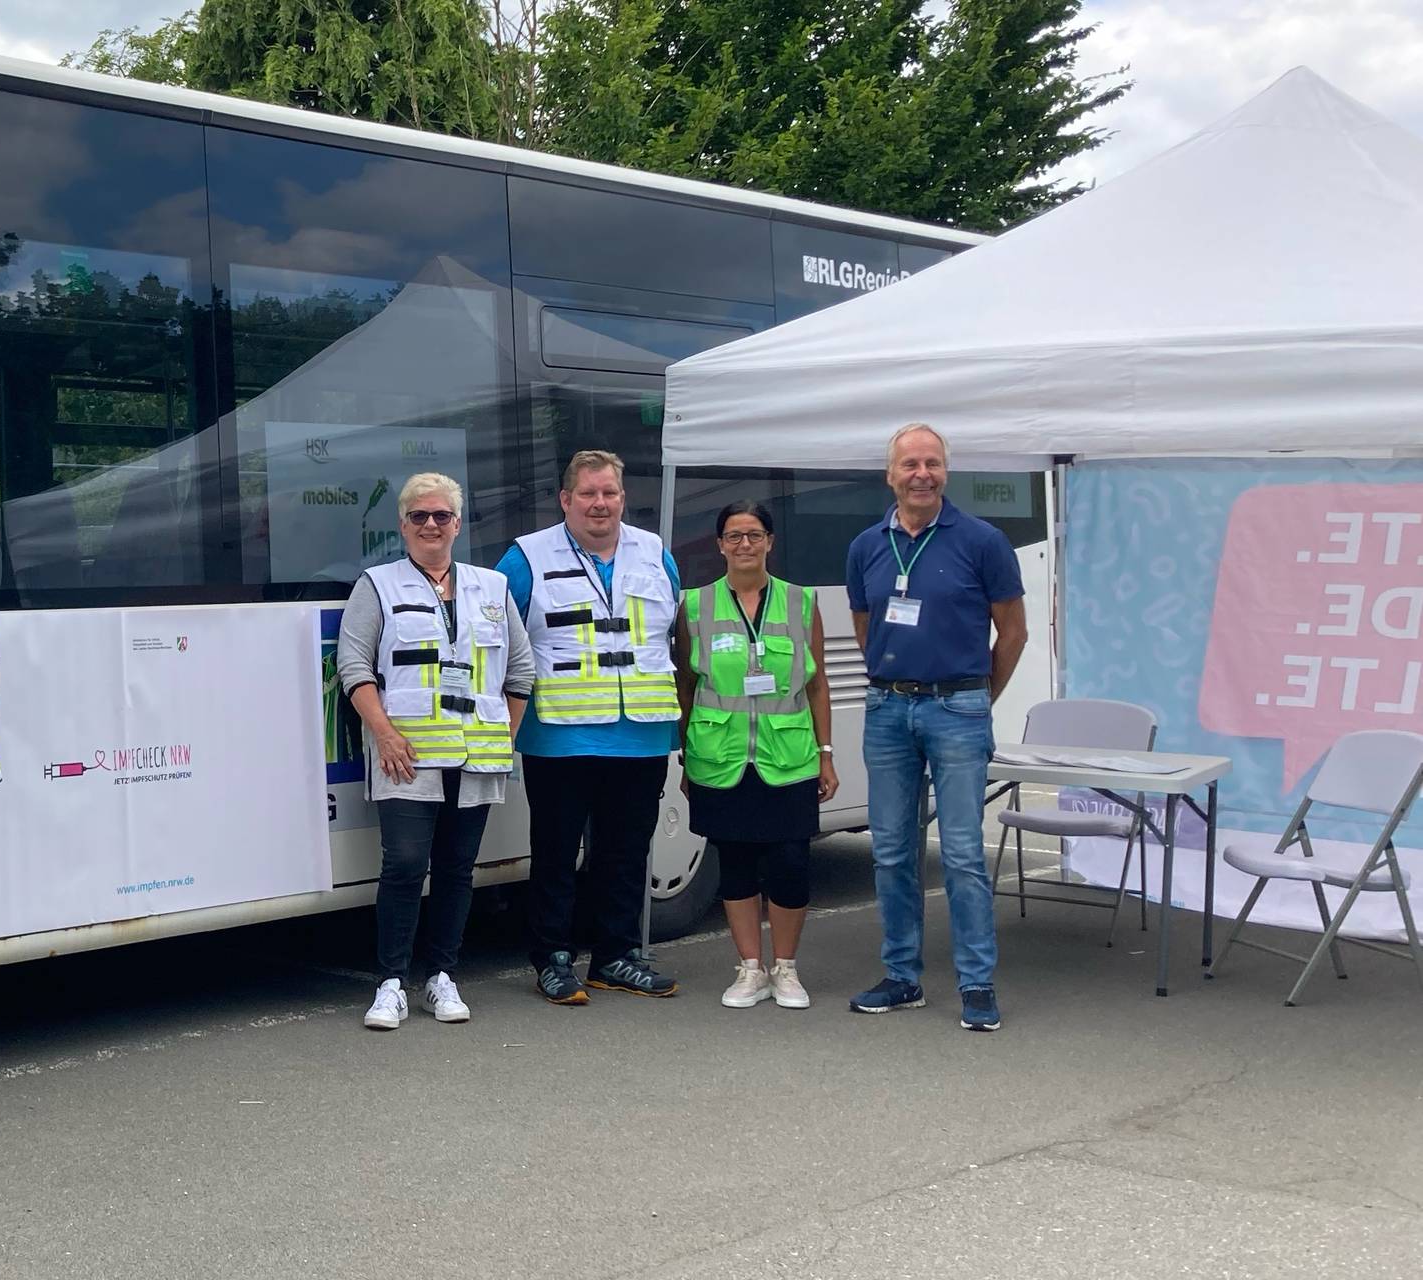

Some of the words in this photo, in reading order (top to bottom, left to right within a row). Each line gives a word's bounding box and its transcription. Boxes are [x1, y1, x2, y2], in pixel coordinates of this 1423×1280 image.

[305, 438, 329, 457] HSK
[302, 487, 359, 505] mobiles
[113, 746, 167, 771] IMPFCHECK
[170, 744, 192, 767] NRW
[116, 875, 195, 895] www.impfen.nrw.de
